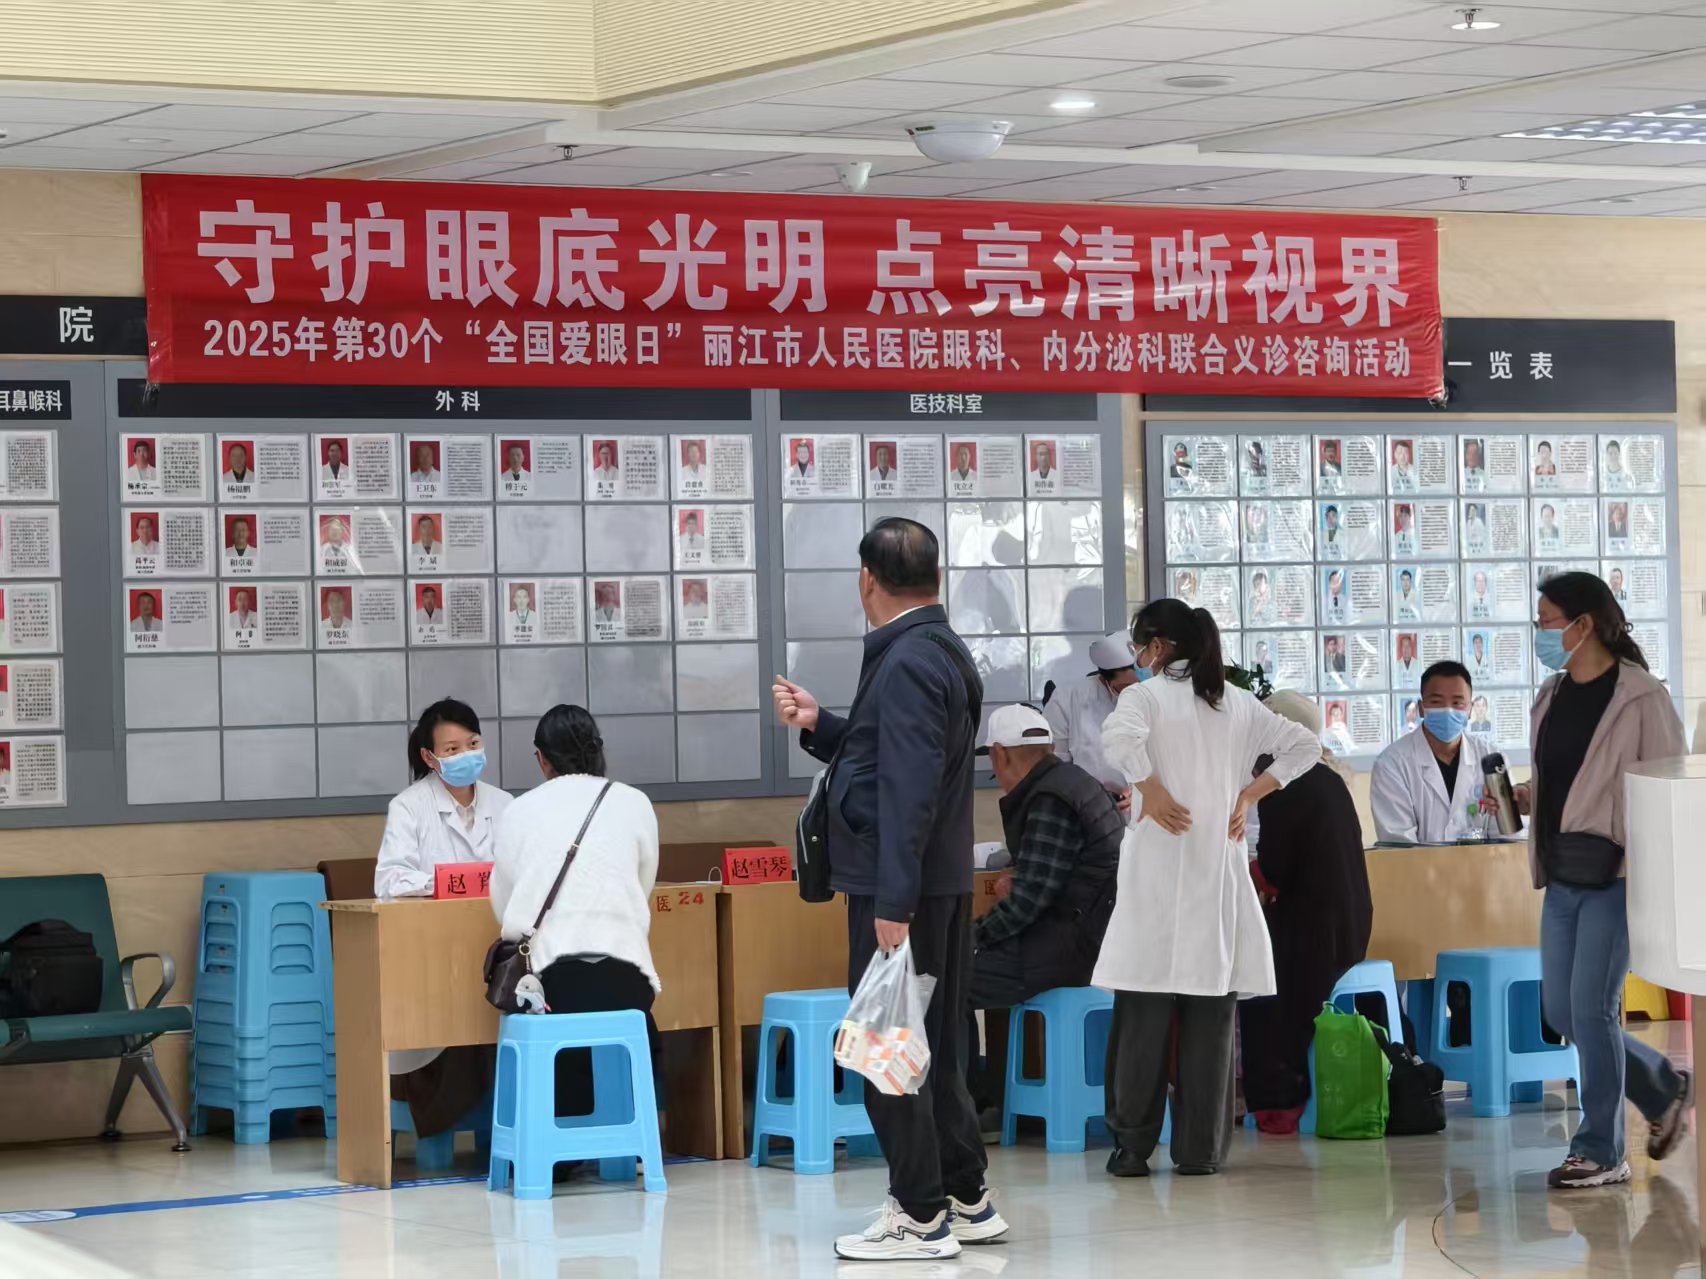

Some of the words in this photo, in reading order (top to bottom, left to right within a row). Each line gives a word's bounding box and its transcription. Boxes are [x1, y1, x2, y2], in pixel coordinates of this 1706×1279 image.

[198, 199, 828, 314] 守护眼底光明
[867, 218, 1410, 328] 点亮清晰视界
[59, 306, 95, 343] 院
[435, 390, 481, 412] 外科
[910, 393, 983, 414] 医技科室
[732, 856, 788, 879] 赵雪琴
[678, 891, 704, 905] 24
